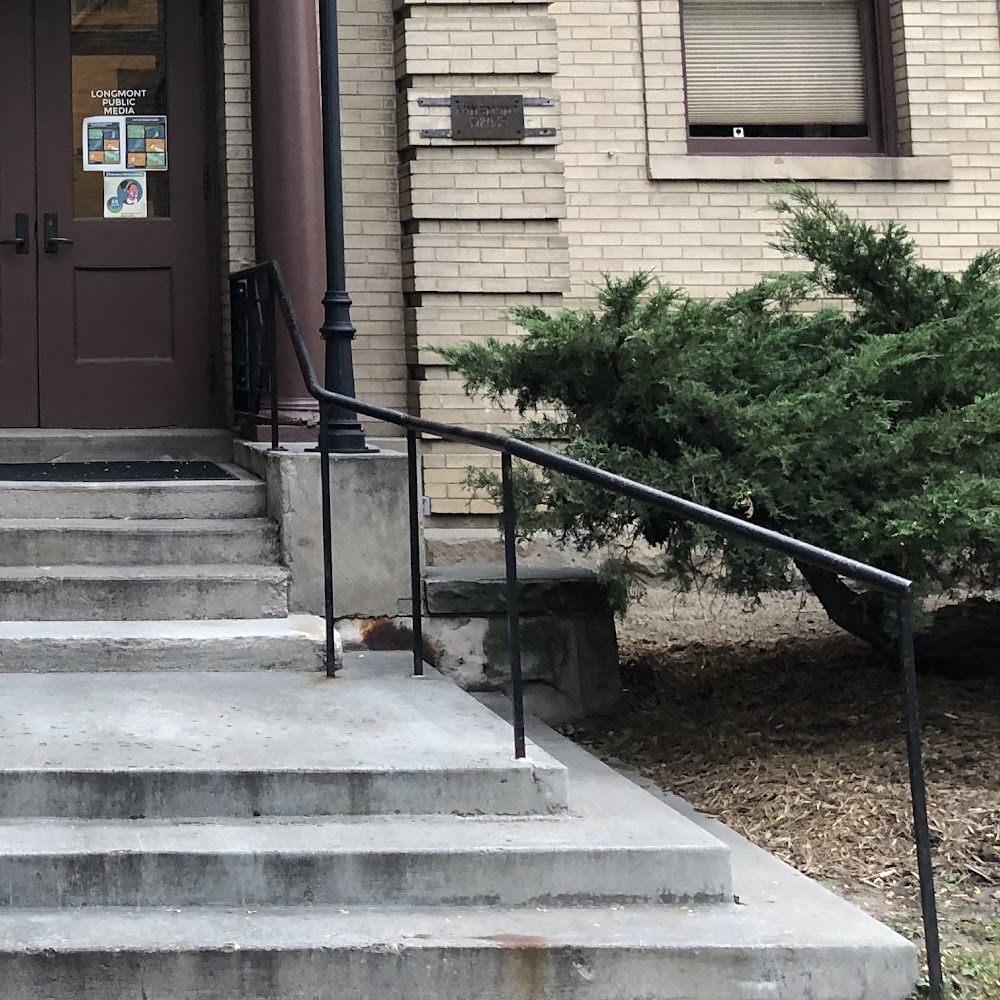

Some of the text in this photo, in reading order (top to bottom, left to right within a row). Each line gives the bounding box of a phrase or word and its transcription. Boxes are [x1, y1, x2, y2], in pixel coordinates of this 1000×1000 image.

[91, 89, 147, 98] LONGMONT
[102, 98, 136, 106] PUBLIC
[103, 107, 135, 115] MEDIA
